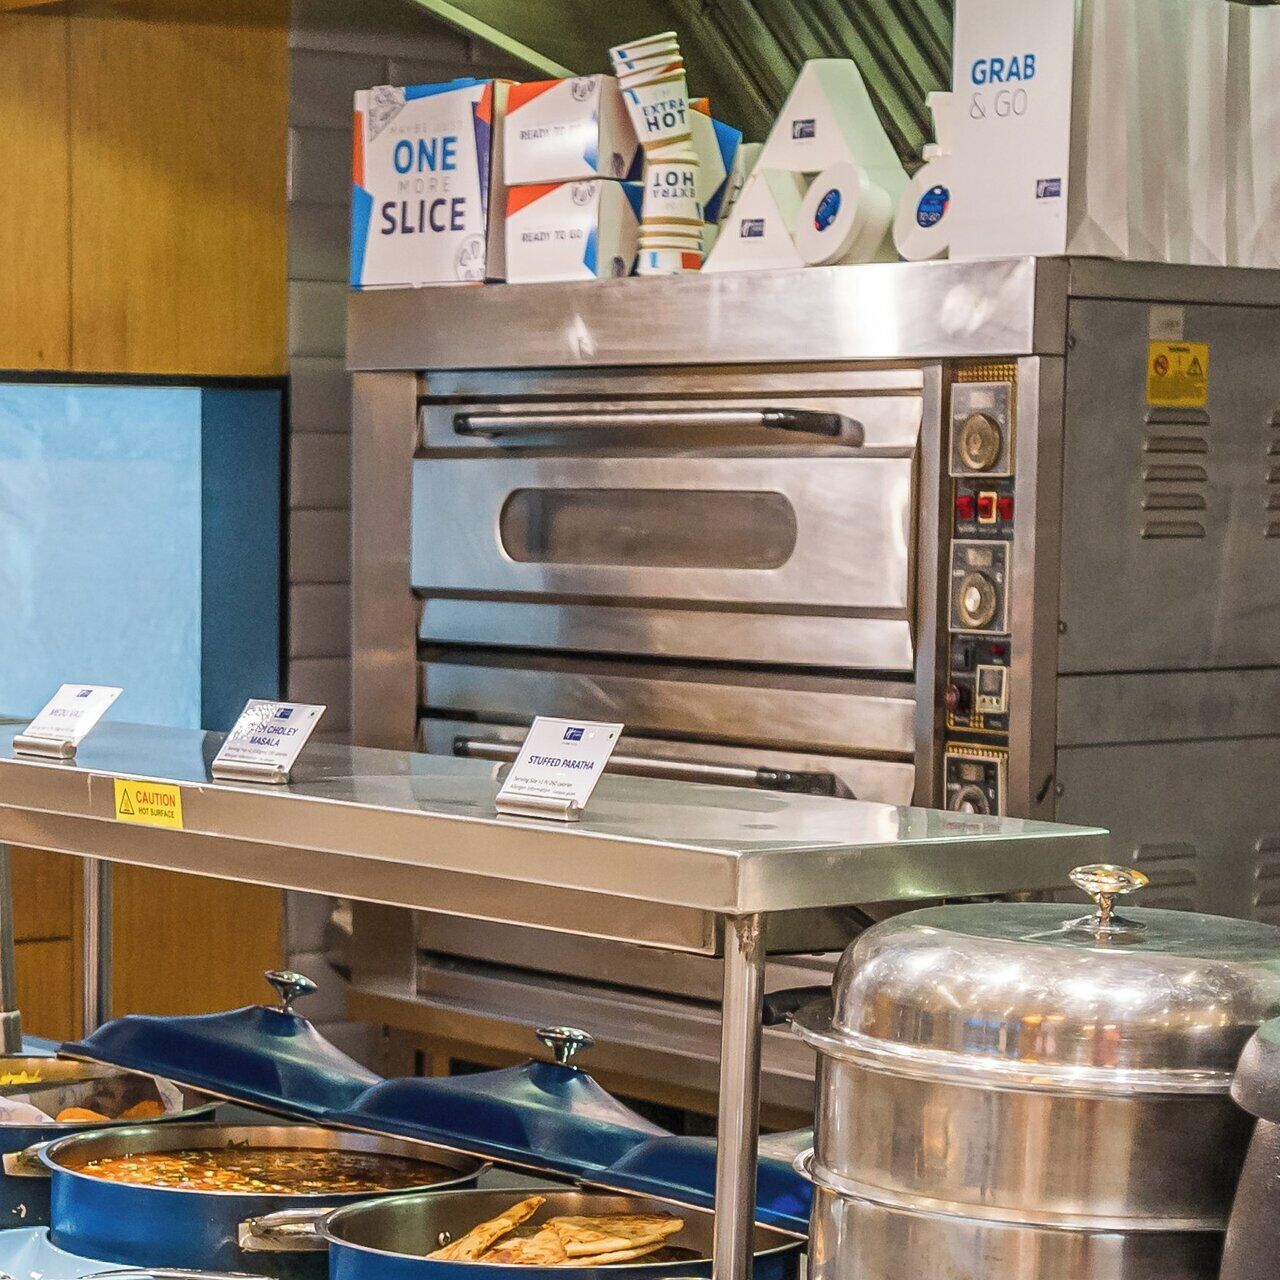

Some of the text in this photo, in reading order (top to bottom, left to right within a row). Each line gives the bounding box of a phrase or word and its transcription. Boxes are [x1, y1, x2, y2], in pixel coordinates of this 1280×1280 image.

[971, 53, 1036, 86] GRAB
[642, 98, 685, 116] EXTRA
[969, 89, 1029, 120] & GO
[646, 109, 686, 133] HOT
[393, 136, 458, 175] ONE
[398, 177, 453, 195] MORE
[655, 171, 695, 187] HOT
[381, 197, 468, 235] SLICE
[522, 230, 551, 243] READY
[266, 725, 299, 736] CHOLEY
[249, 736, 280, 747] MASALA
[528, 755, 595, 771] STUFFED PARATHA
[135, 790, 176, 807] CAUTION
[138, 807, 175, 819] HOT SURFACE
